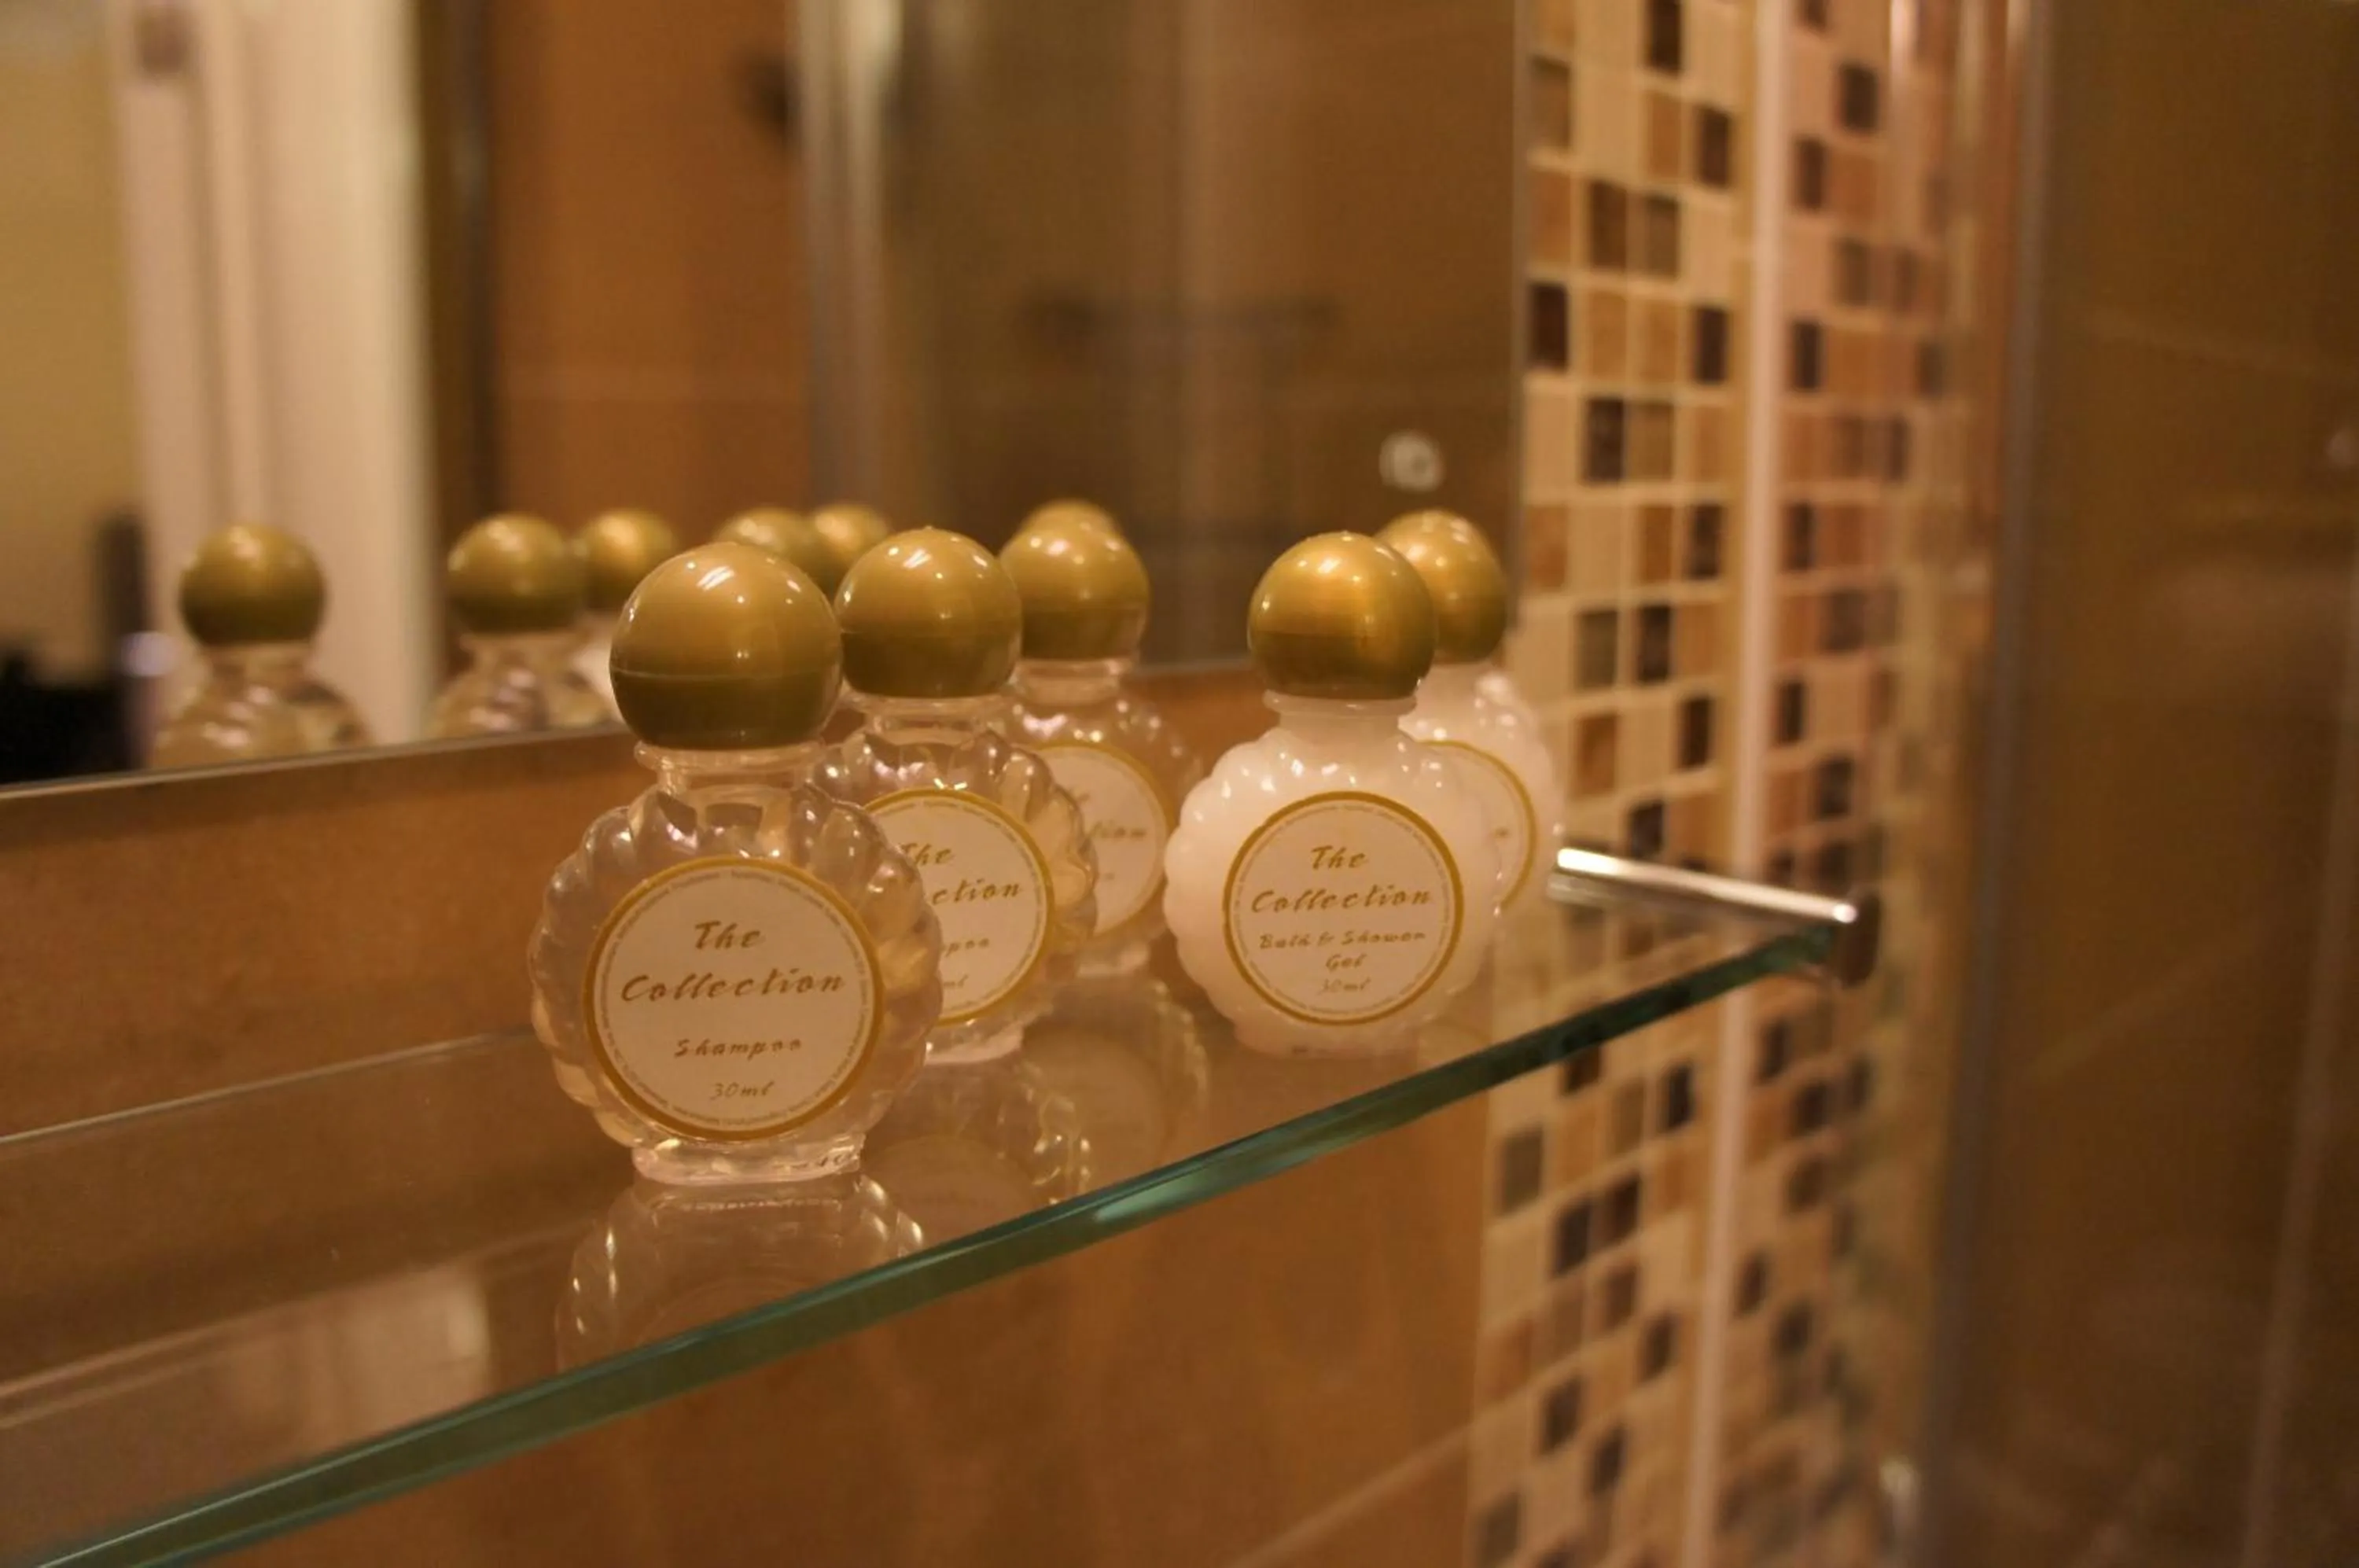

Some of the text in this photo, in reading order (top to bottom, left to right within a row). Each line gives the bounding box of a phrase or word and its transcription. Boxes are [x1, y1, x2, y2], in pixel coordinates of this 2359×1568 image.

[1310, 845, 1369, 870] The
[932, 878, 1021, 905] ction
[1251, 885, 1432, 914] Collection
[694, 919, 765, 950] The
[1259, 933, 1311, 949] Bath
[1341, 929, 1426, 946] Shower
[1325, 954, 1367, 973] Gel
[620, 968, 847, 1002] Collection
[674, 1038, 803, 1061] Shampoo
[709, 1080, 775, 1101] 30ml
